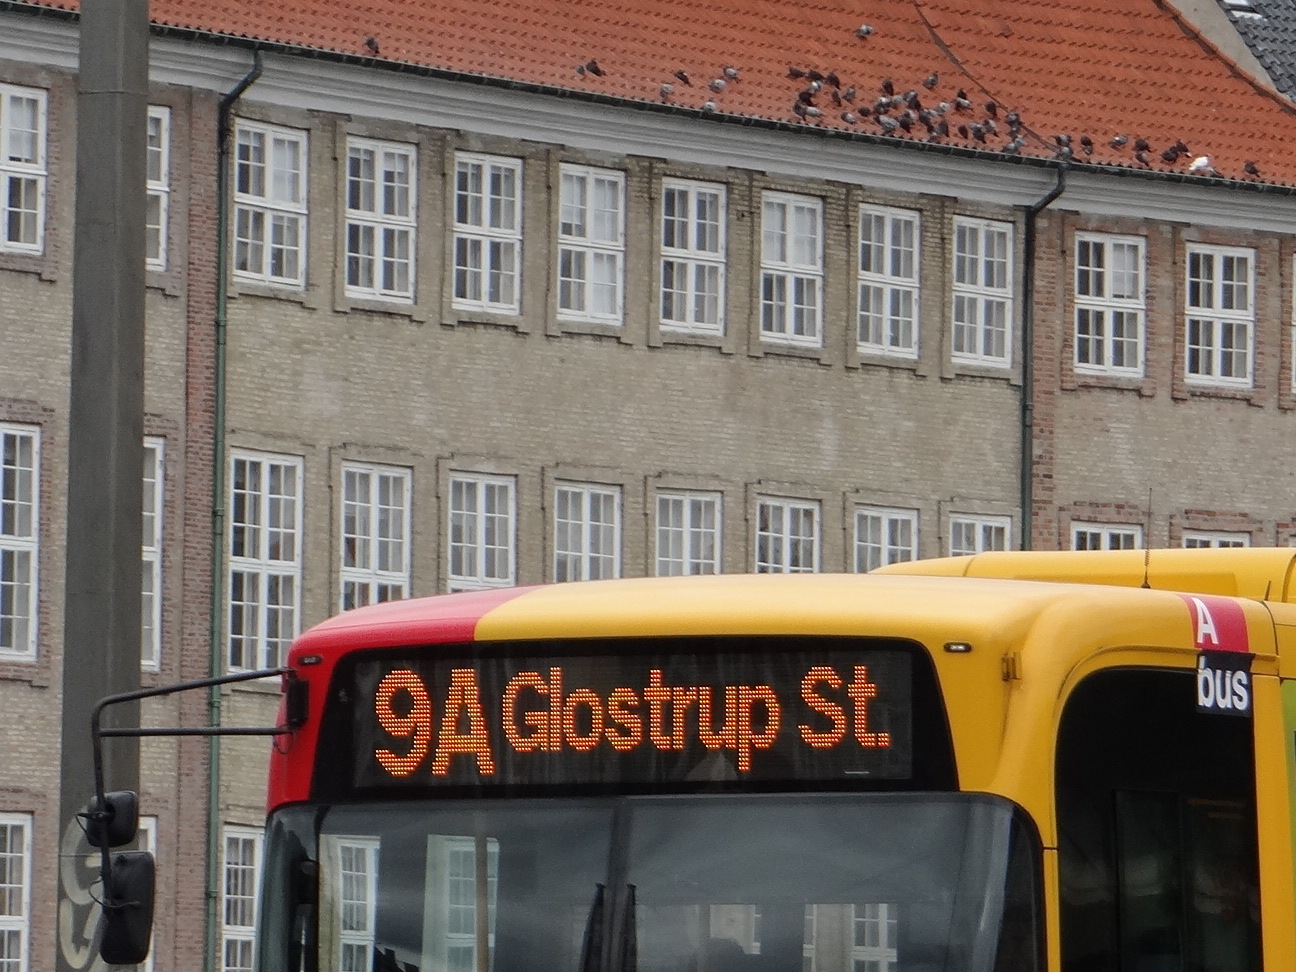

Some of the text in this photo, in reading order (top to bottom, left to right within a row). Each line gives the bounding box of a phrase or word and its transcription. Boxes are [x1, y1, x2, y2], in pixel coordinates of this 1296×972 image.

[1191, 596, 1220, 645] A
[1197, 655, 1249, 711] bus
[374, 665, 891, 776] 9A Glostrup St.
